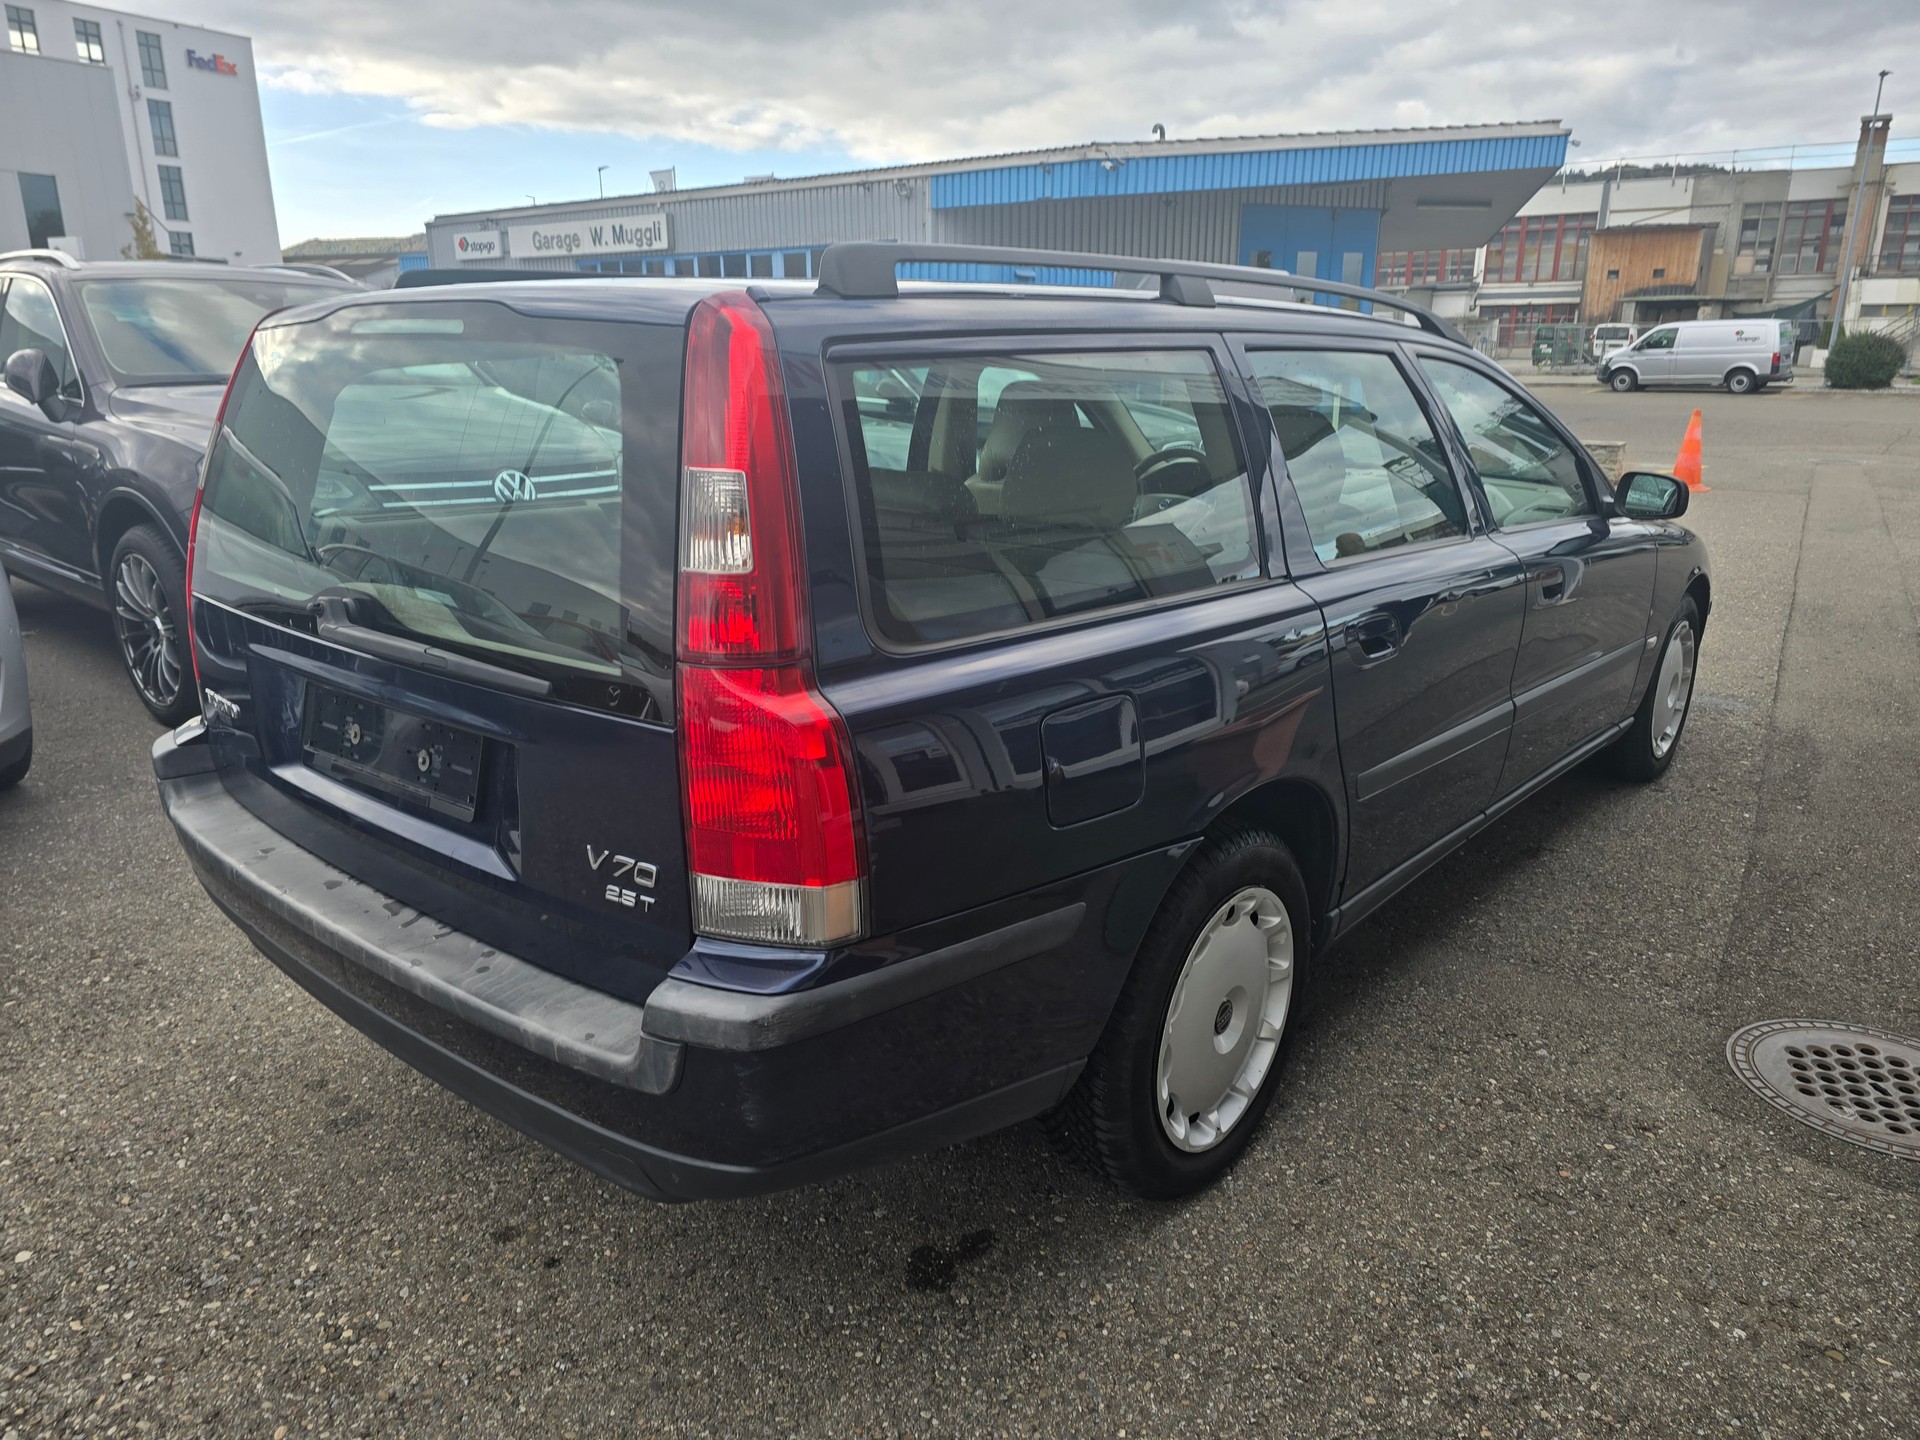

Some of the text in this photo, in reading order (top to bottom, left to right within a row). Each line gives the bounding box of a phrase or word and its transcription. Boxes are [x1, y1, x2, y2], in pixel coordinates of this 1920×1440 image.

[186, 48, 238, 76] FedEx
[532, 220, 662, 253] Garage W. Muggli
